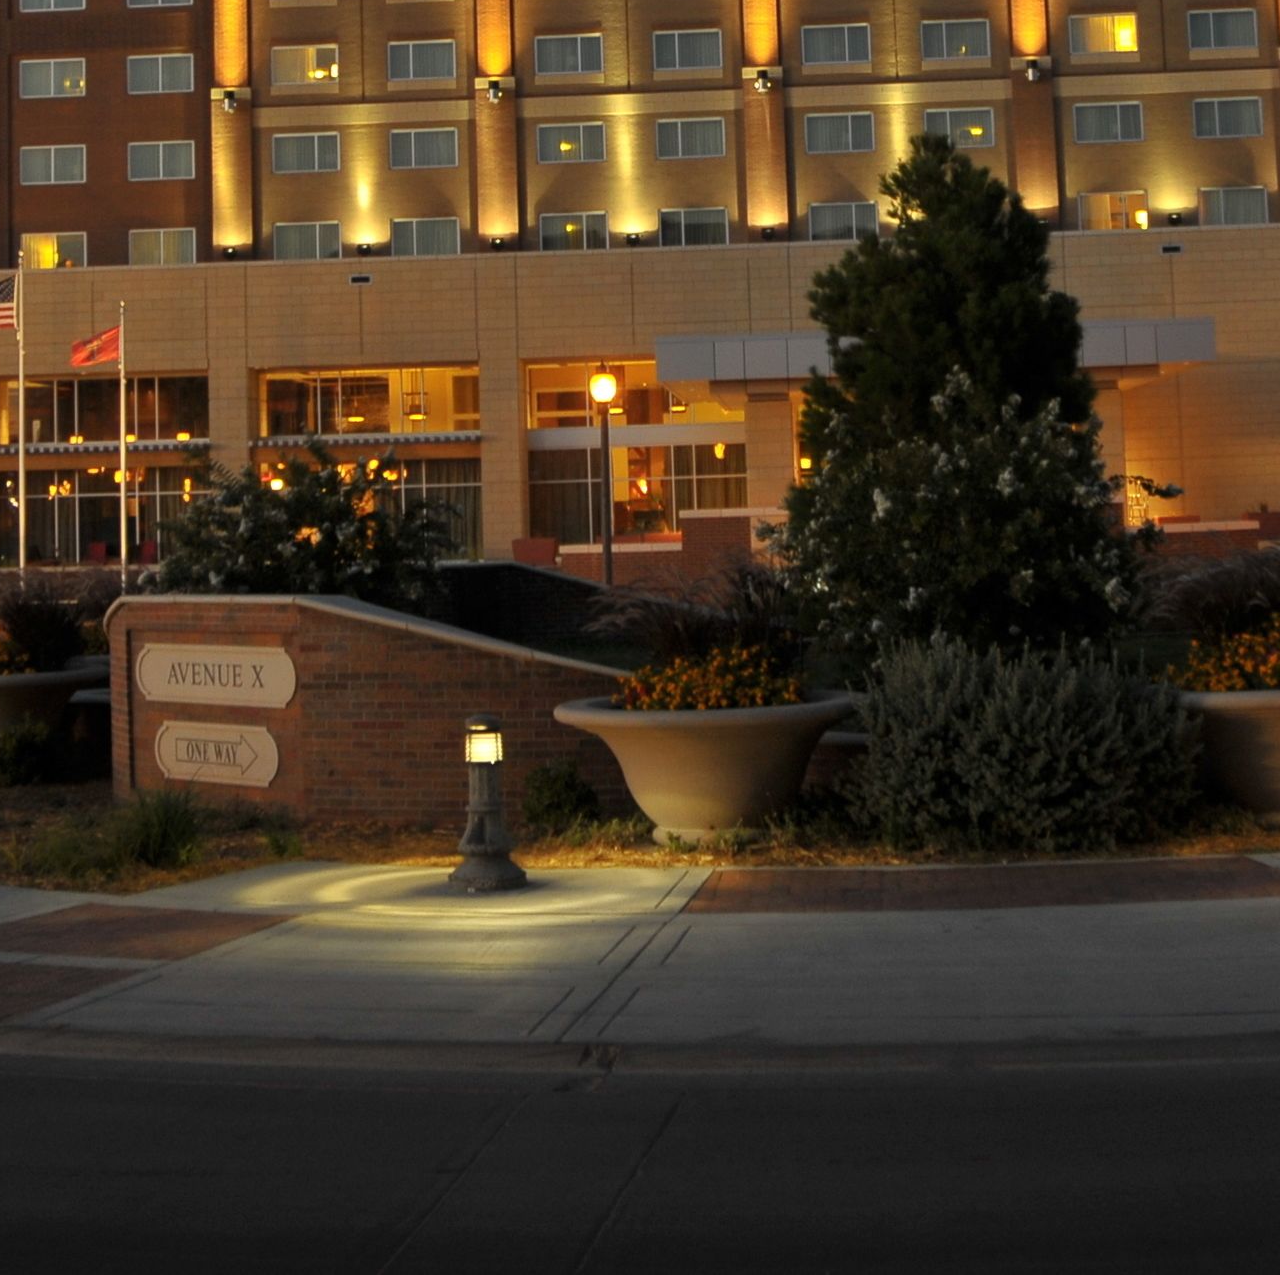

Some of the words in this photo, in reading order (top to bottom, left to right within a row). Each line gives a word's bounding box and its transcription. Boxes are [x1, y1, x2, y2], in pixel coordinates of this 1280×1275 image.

[167, 662, 243, 687] AVENUE
[251, 665, 264, 688] X
[186, 741, 210, 762] ONE
[214, 743, 238, 764] WAY
